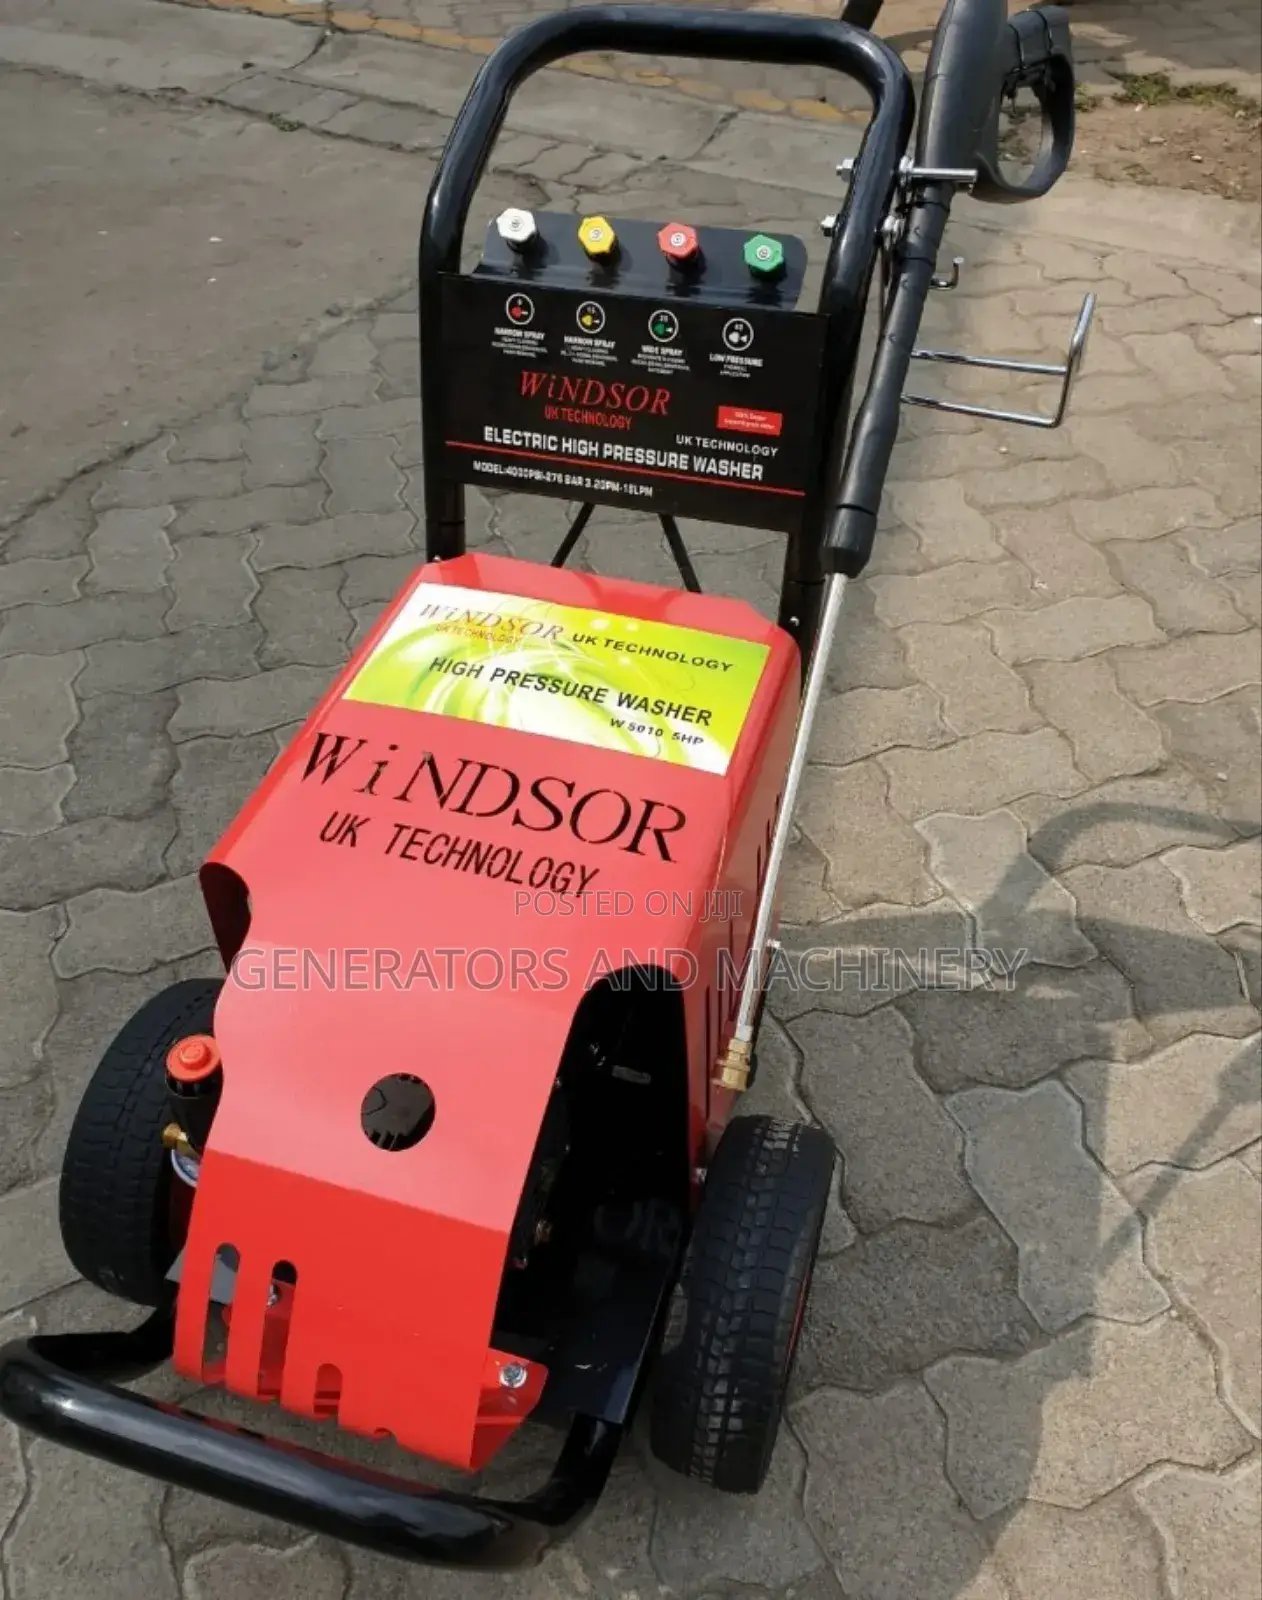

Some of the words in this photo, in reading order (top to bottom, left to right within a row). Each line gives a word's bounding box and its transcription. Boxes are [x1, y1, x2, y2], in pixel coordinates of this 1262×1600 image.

[544, 405, 559, 420] UK
[561, 407, 632, 430] TECHNOLOGY
[484, 425, 558, 451] ELECTRIC
[562, 436, 599, 457] HIGH
[603, 443, 689, 470] PRESSURE
[693, 455, 764, 481] WASHER
[676, 434, 693, 446] UK
[695, 436, 779, 457] TECHNOLOGY
[572, 633, 597, 647] UK
[604, 639, 733, 672] TECHNOLOGY
[429, 656, 484, 680] HIGH
[490, 669, 608, 704] PRESSURE
[618, 691, 712, 727] WASHER
[610, 718, 626, 729] W
[628, 720, 664, 738] 5010
[672, 731, 704, 746] 5HP
[319, 810, 370, 849] UK
[384, 823, 600, 899] TECHNOLOGY
